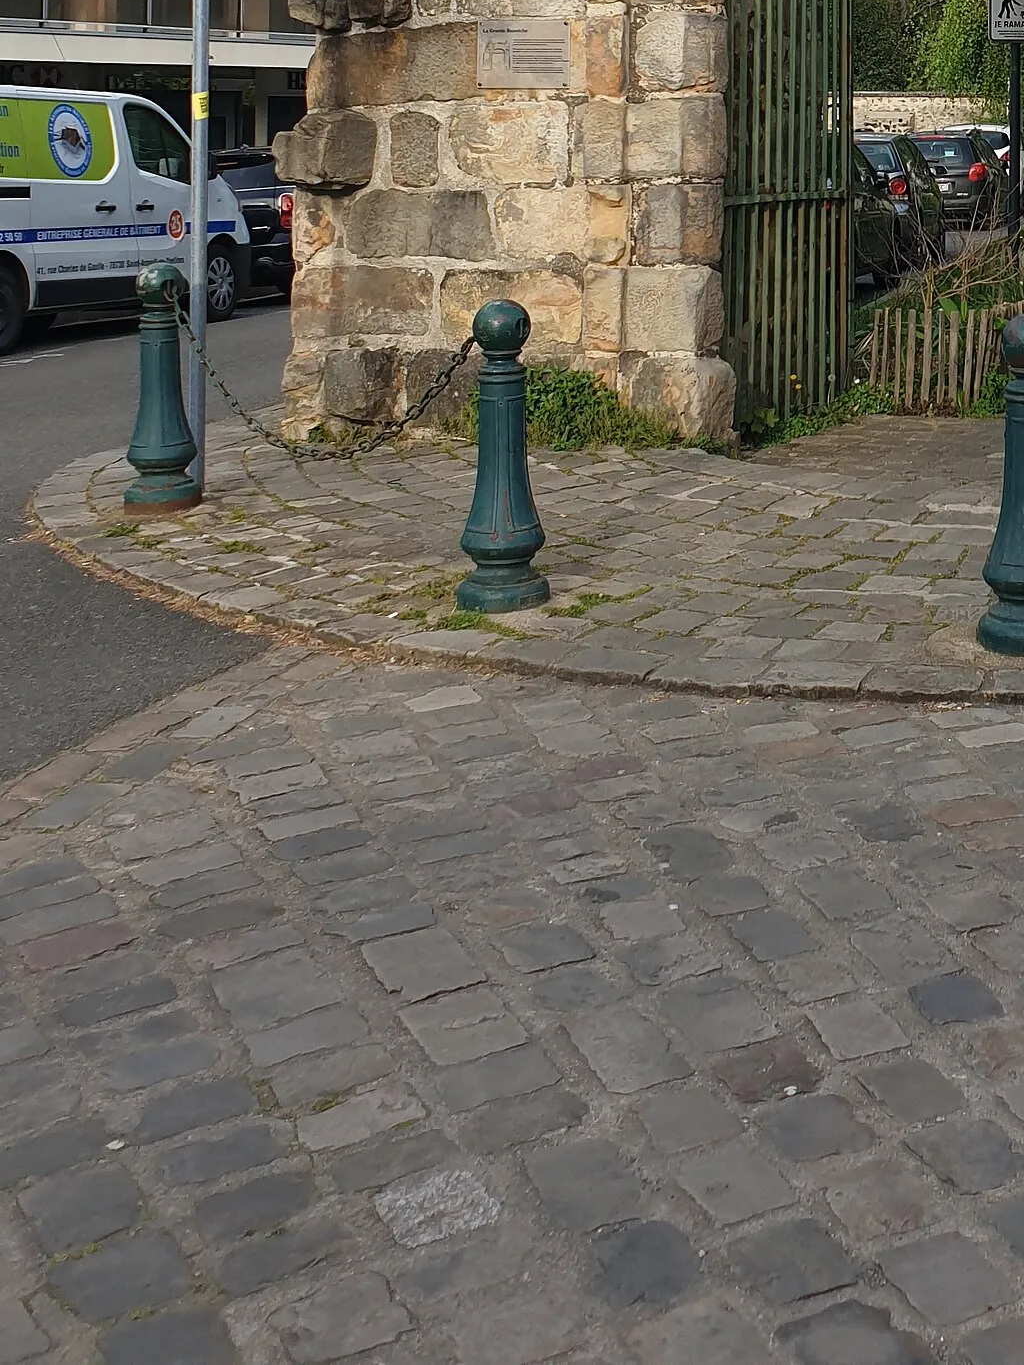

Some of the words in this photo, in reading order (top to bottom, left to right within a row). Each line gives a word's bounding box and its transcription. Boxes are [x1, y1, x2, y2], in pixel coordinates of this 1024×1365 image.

[171, 214, 181, 234] 25
[37, 229, 83, 241] ENTREPRISE
[119, 227, 129, 236] DE
[79, 264, 87, 272] de
